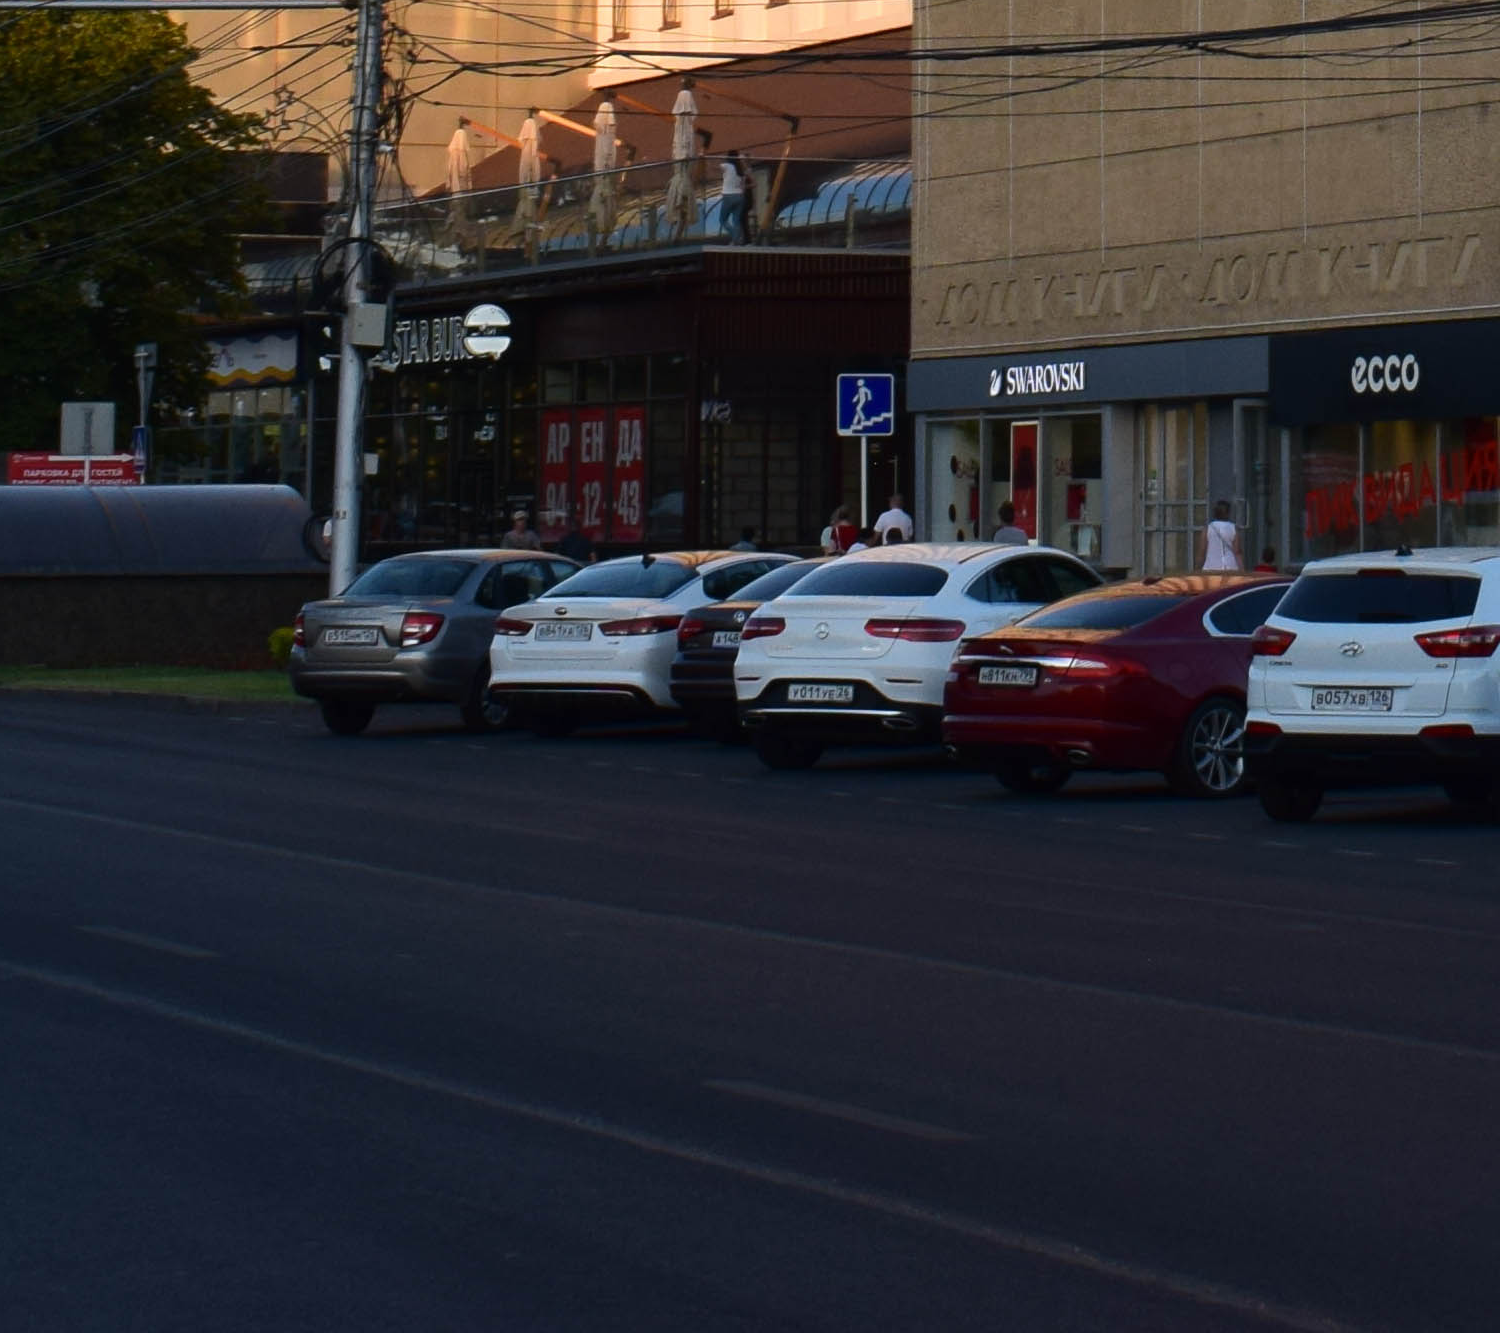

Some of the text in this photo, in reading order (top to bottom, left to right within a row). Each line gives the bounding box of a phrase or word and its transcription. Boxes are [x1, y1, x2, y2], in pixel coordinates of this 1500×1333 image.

[1006, 362, 1085, 395] SWAROVSKI
[1351, 353, 1420, 394] ecco
[22, 468, 69, 478] ПАРКОВКА
